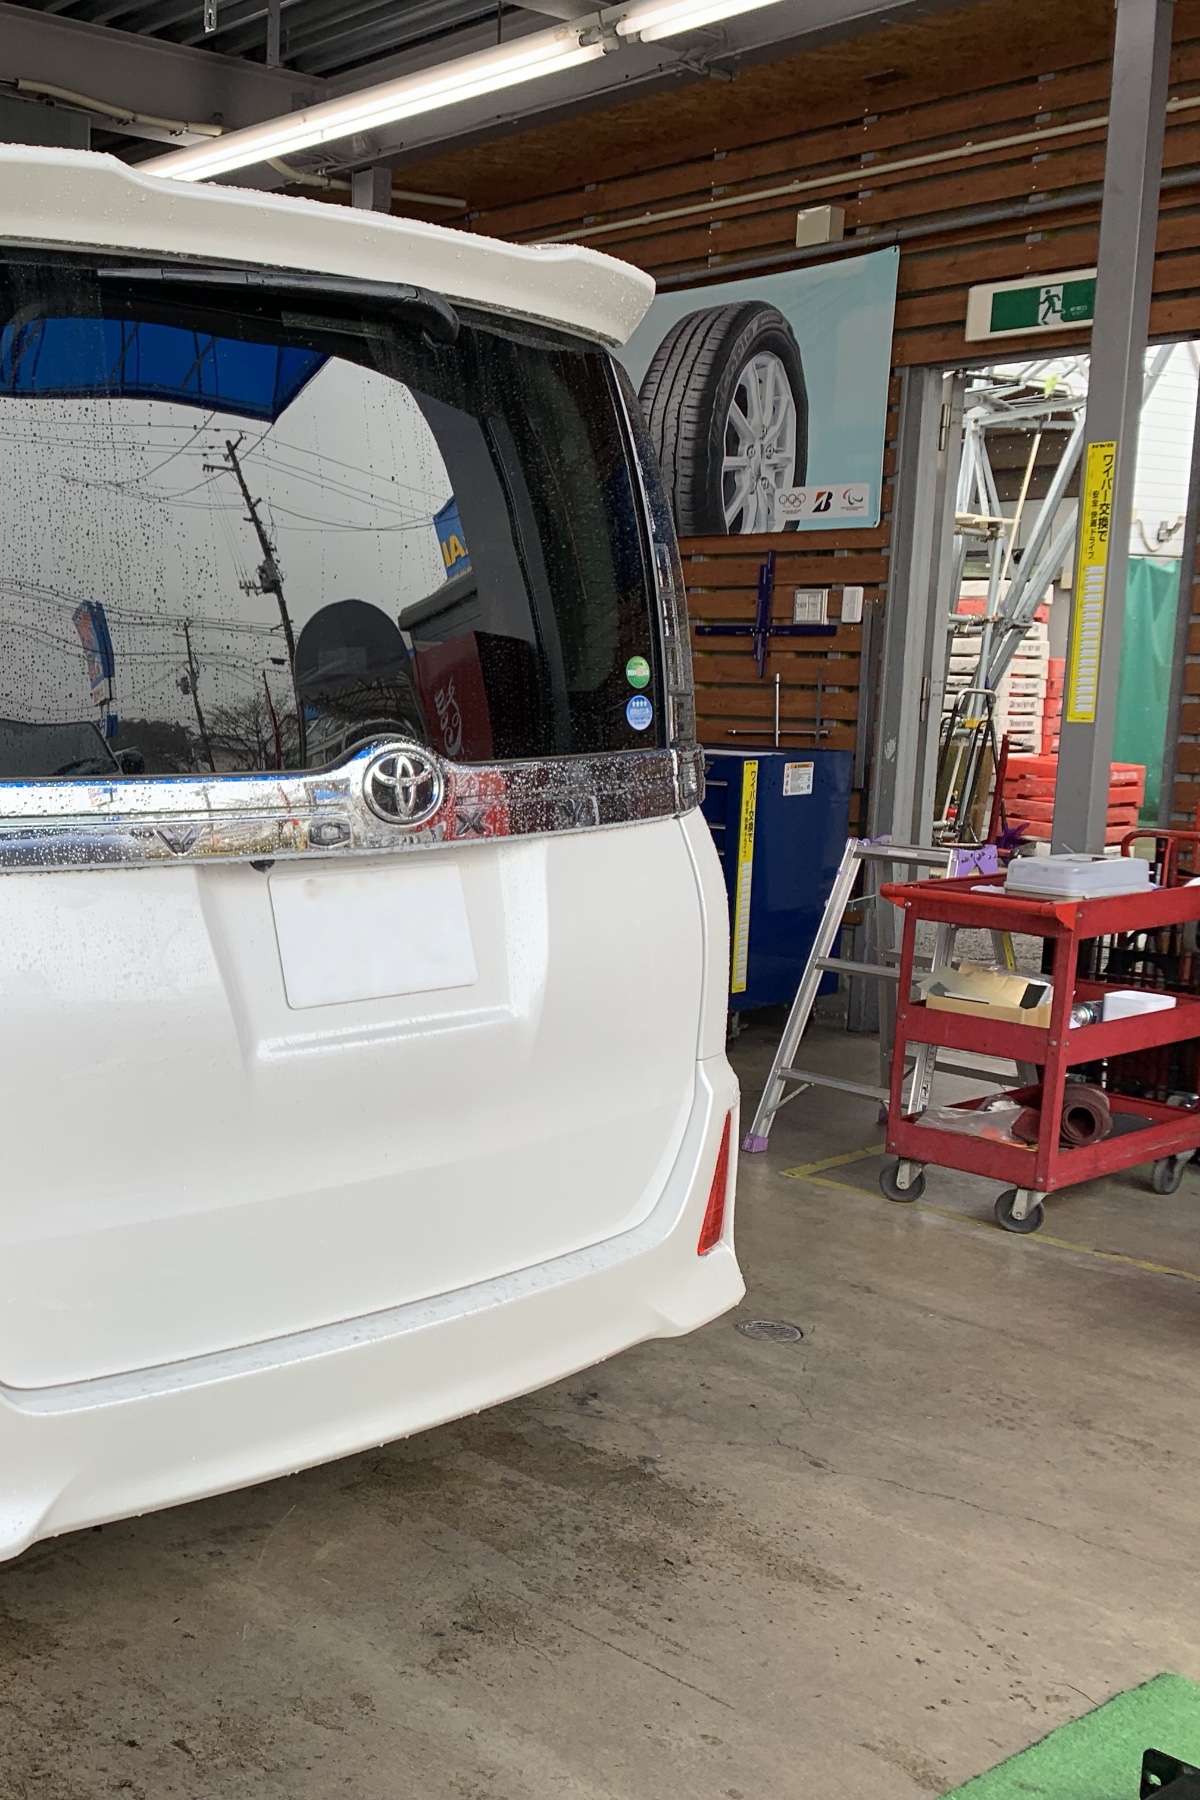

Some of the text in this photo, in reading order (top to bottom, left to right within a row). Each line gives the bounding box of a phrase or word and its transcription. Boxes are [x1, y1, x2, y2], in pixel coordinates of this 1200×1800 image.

[1097, 454, 1114, 542] ワイパー交換で
